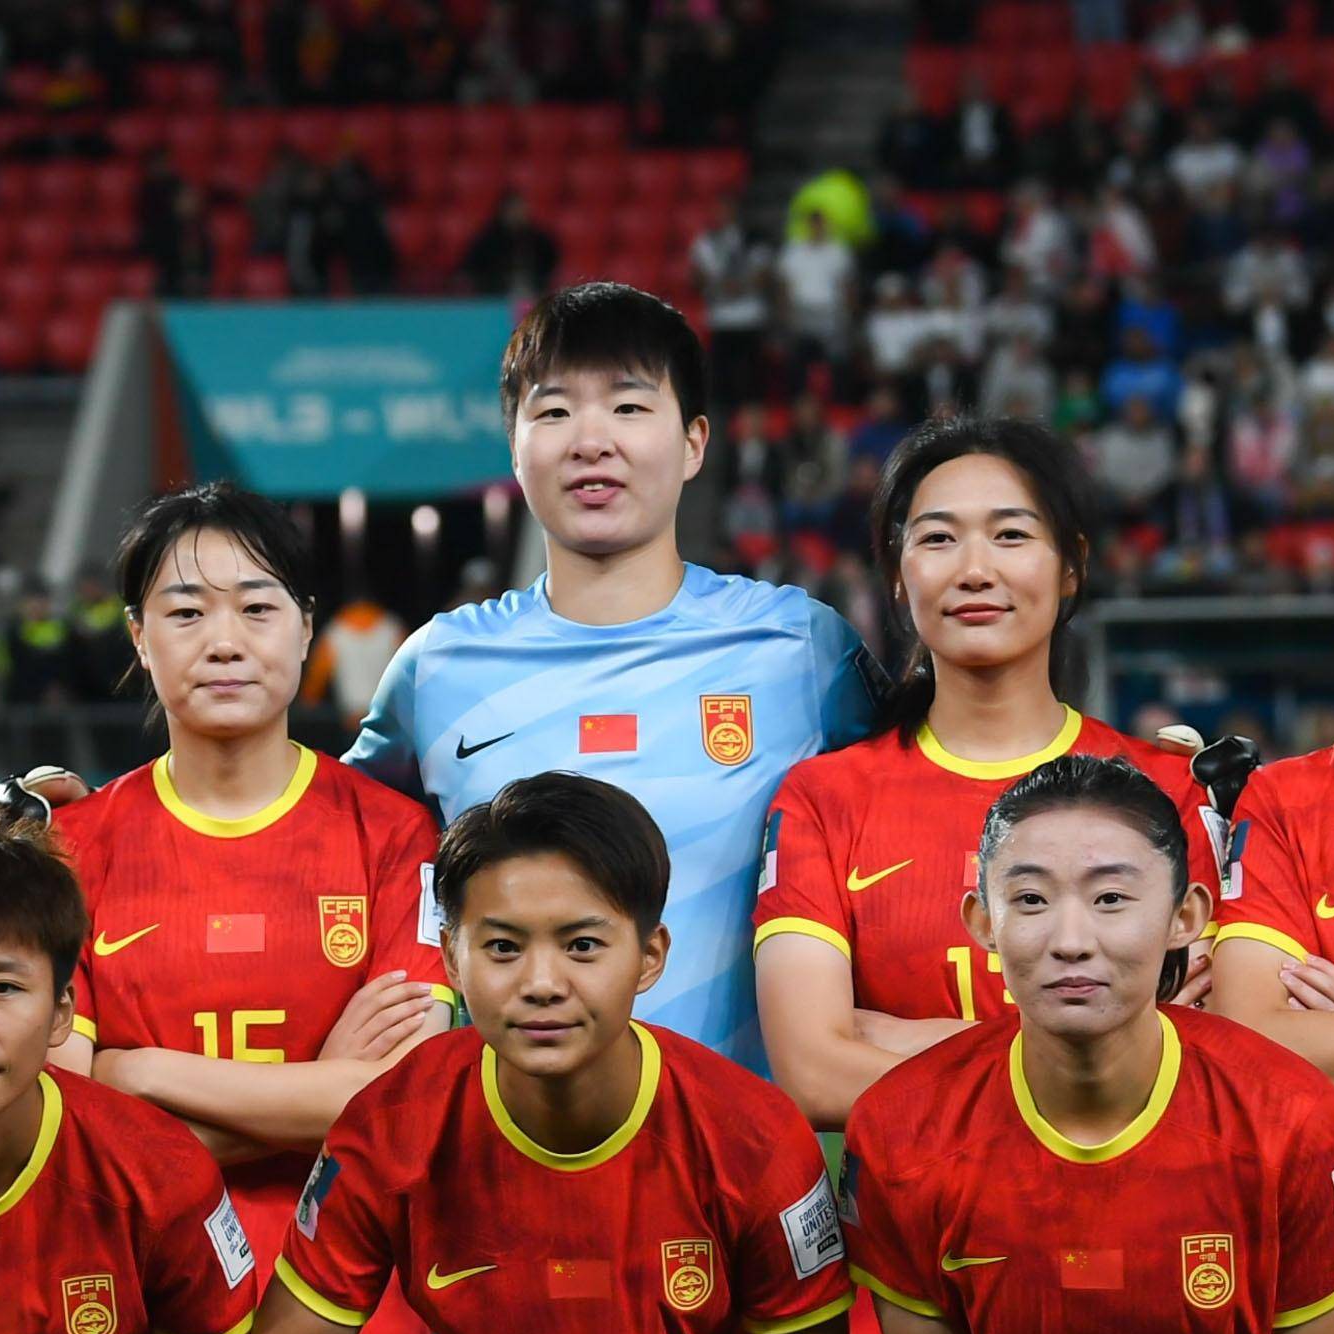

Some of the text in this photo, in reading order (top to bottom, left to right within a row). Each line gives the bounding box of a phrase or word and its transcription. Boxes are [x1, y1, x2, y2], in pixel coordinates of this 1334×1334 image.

[706, 700, 745, 714] CFA
[323, 901, 362, 914] CFA
[666, 1244, 707, 1258] CFA
[1187, 1239, 1228, 1254] CFA
[67, 1279, 109, 1296] CFA
